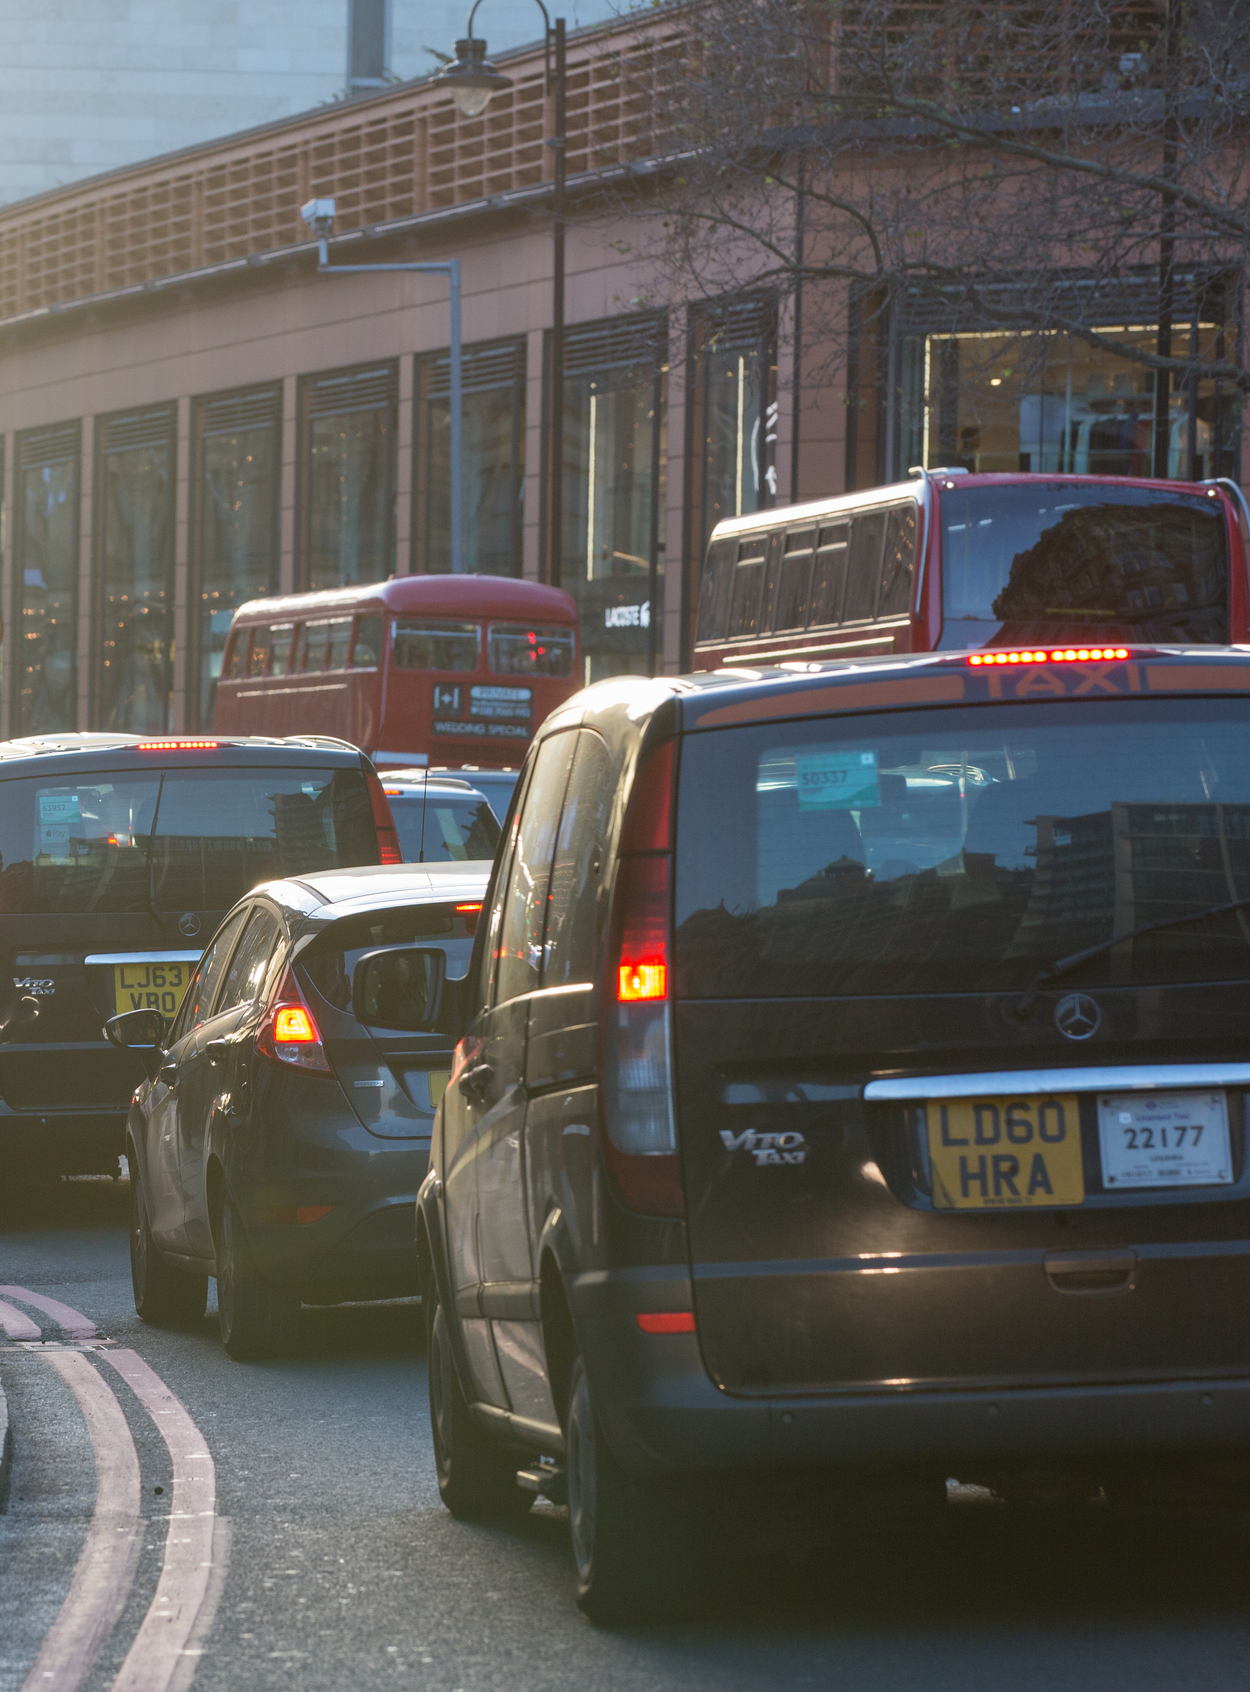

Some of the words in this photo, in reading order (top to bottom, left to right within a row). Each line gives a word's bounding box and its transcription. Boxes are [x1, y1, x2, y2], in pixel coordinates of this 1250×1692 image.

[970, 664, 1142, 698] TAXI
[434, 721, 486, 735] WEDDING
[488, 724, 528, 738] SPECIAL
[42, 804, 66, 812] 63952
[120, 966, 183, 989] LJ63
[939, 1100, 1066, 1147] LD60
[1123, 1125, 1204, 1150] 22177
[959, 1153, 1054, 1198] HRA
